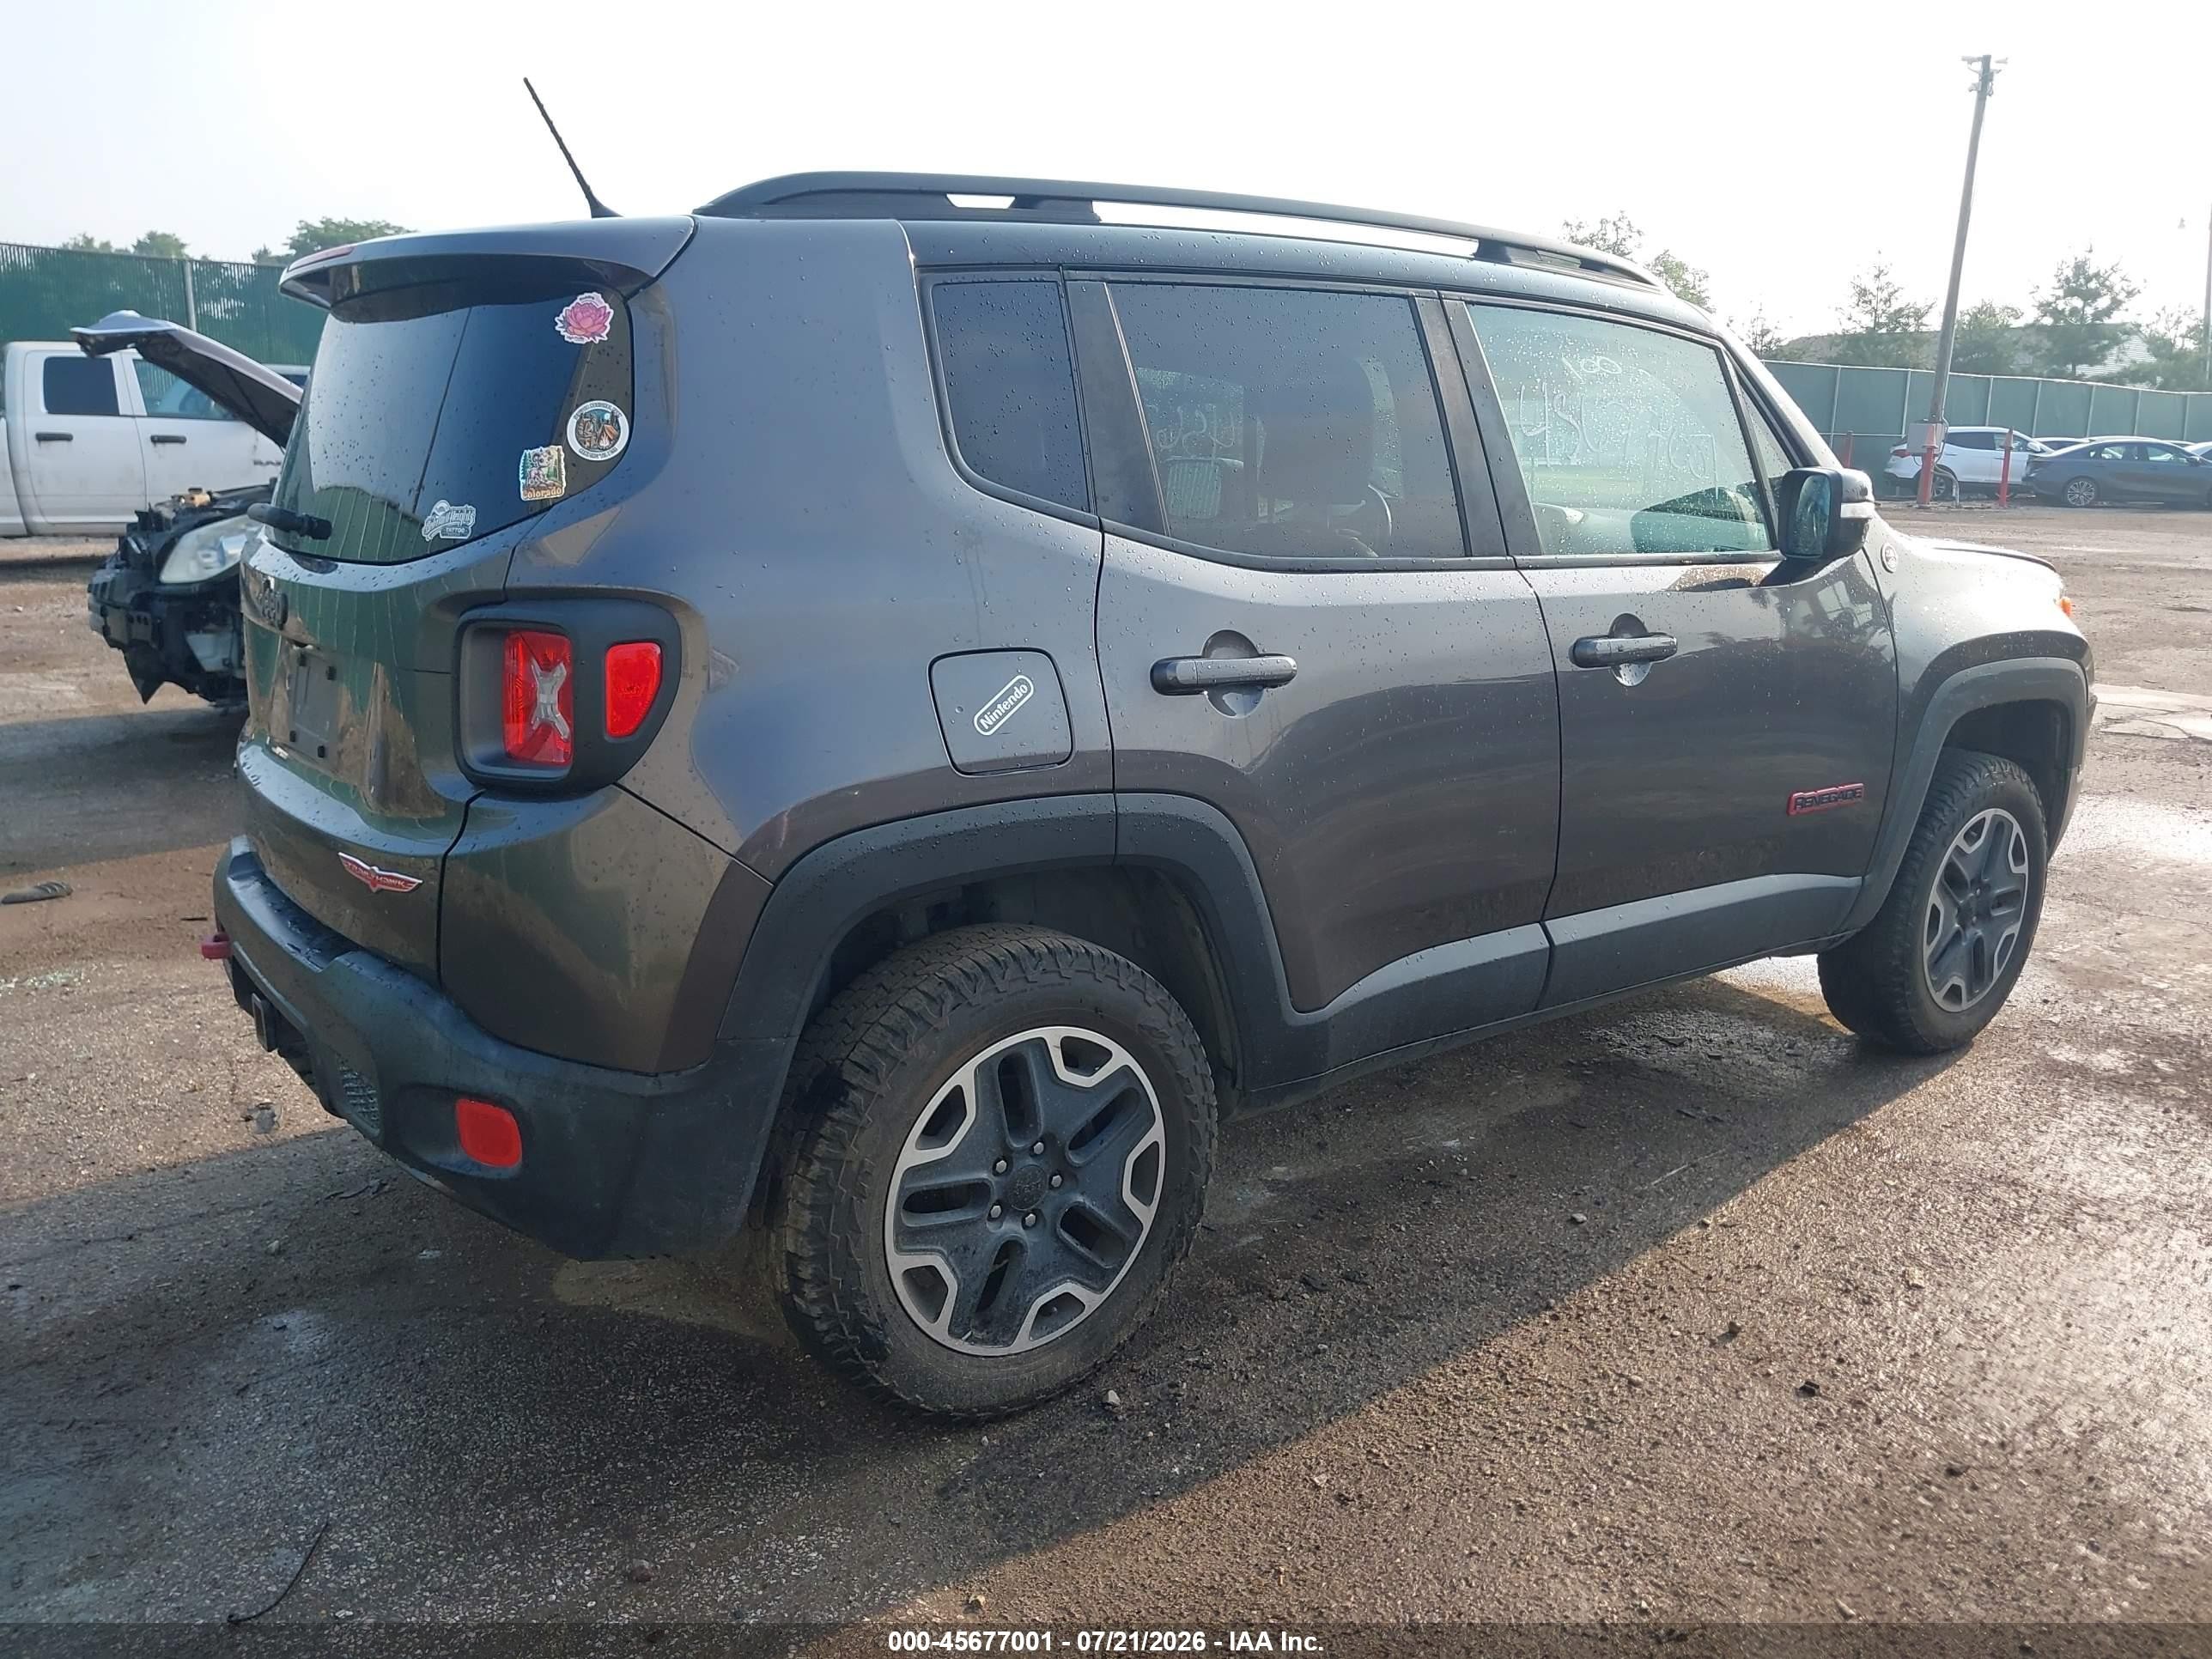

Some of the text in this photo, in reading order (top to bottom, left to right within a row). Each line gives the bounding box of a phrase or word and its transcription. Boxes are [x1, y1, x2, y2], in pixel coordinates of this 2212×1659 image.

[522, 487, 562, 498] Colorado
[979, 683, 1029, 730] Nintendo
[1794, 787, 1863, 810] RENEGADE
